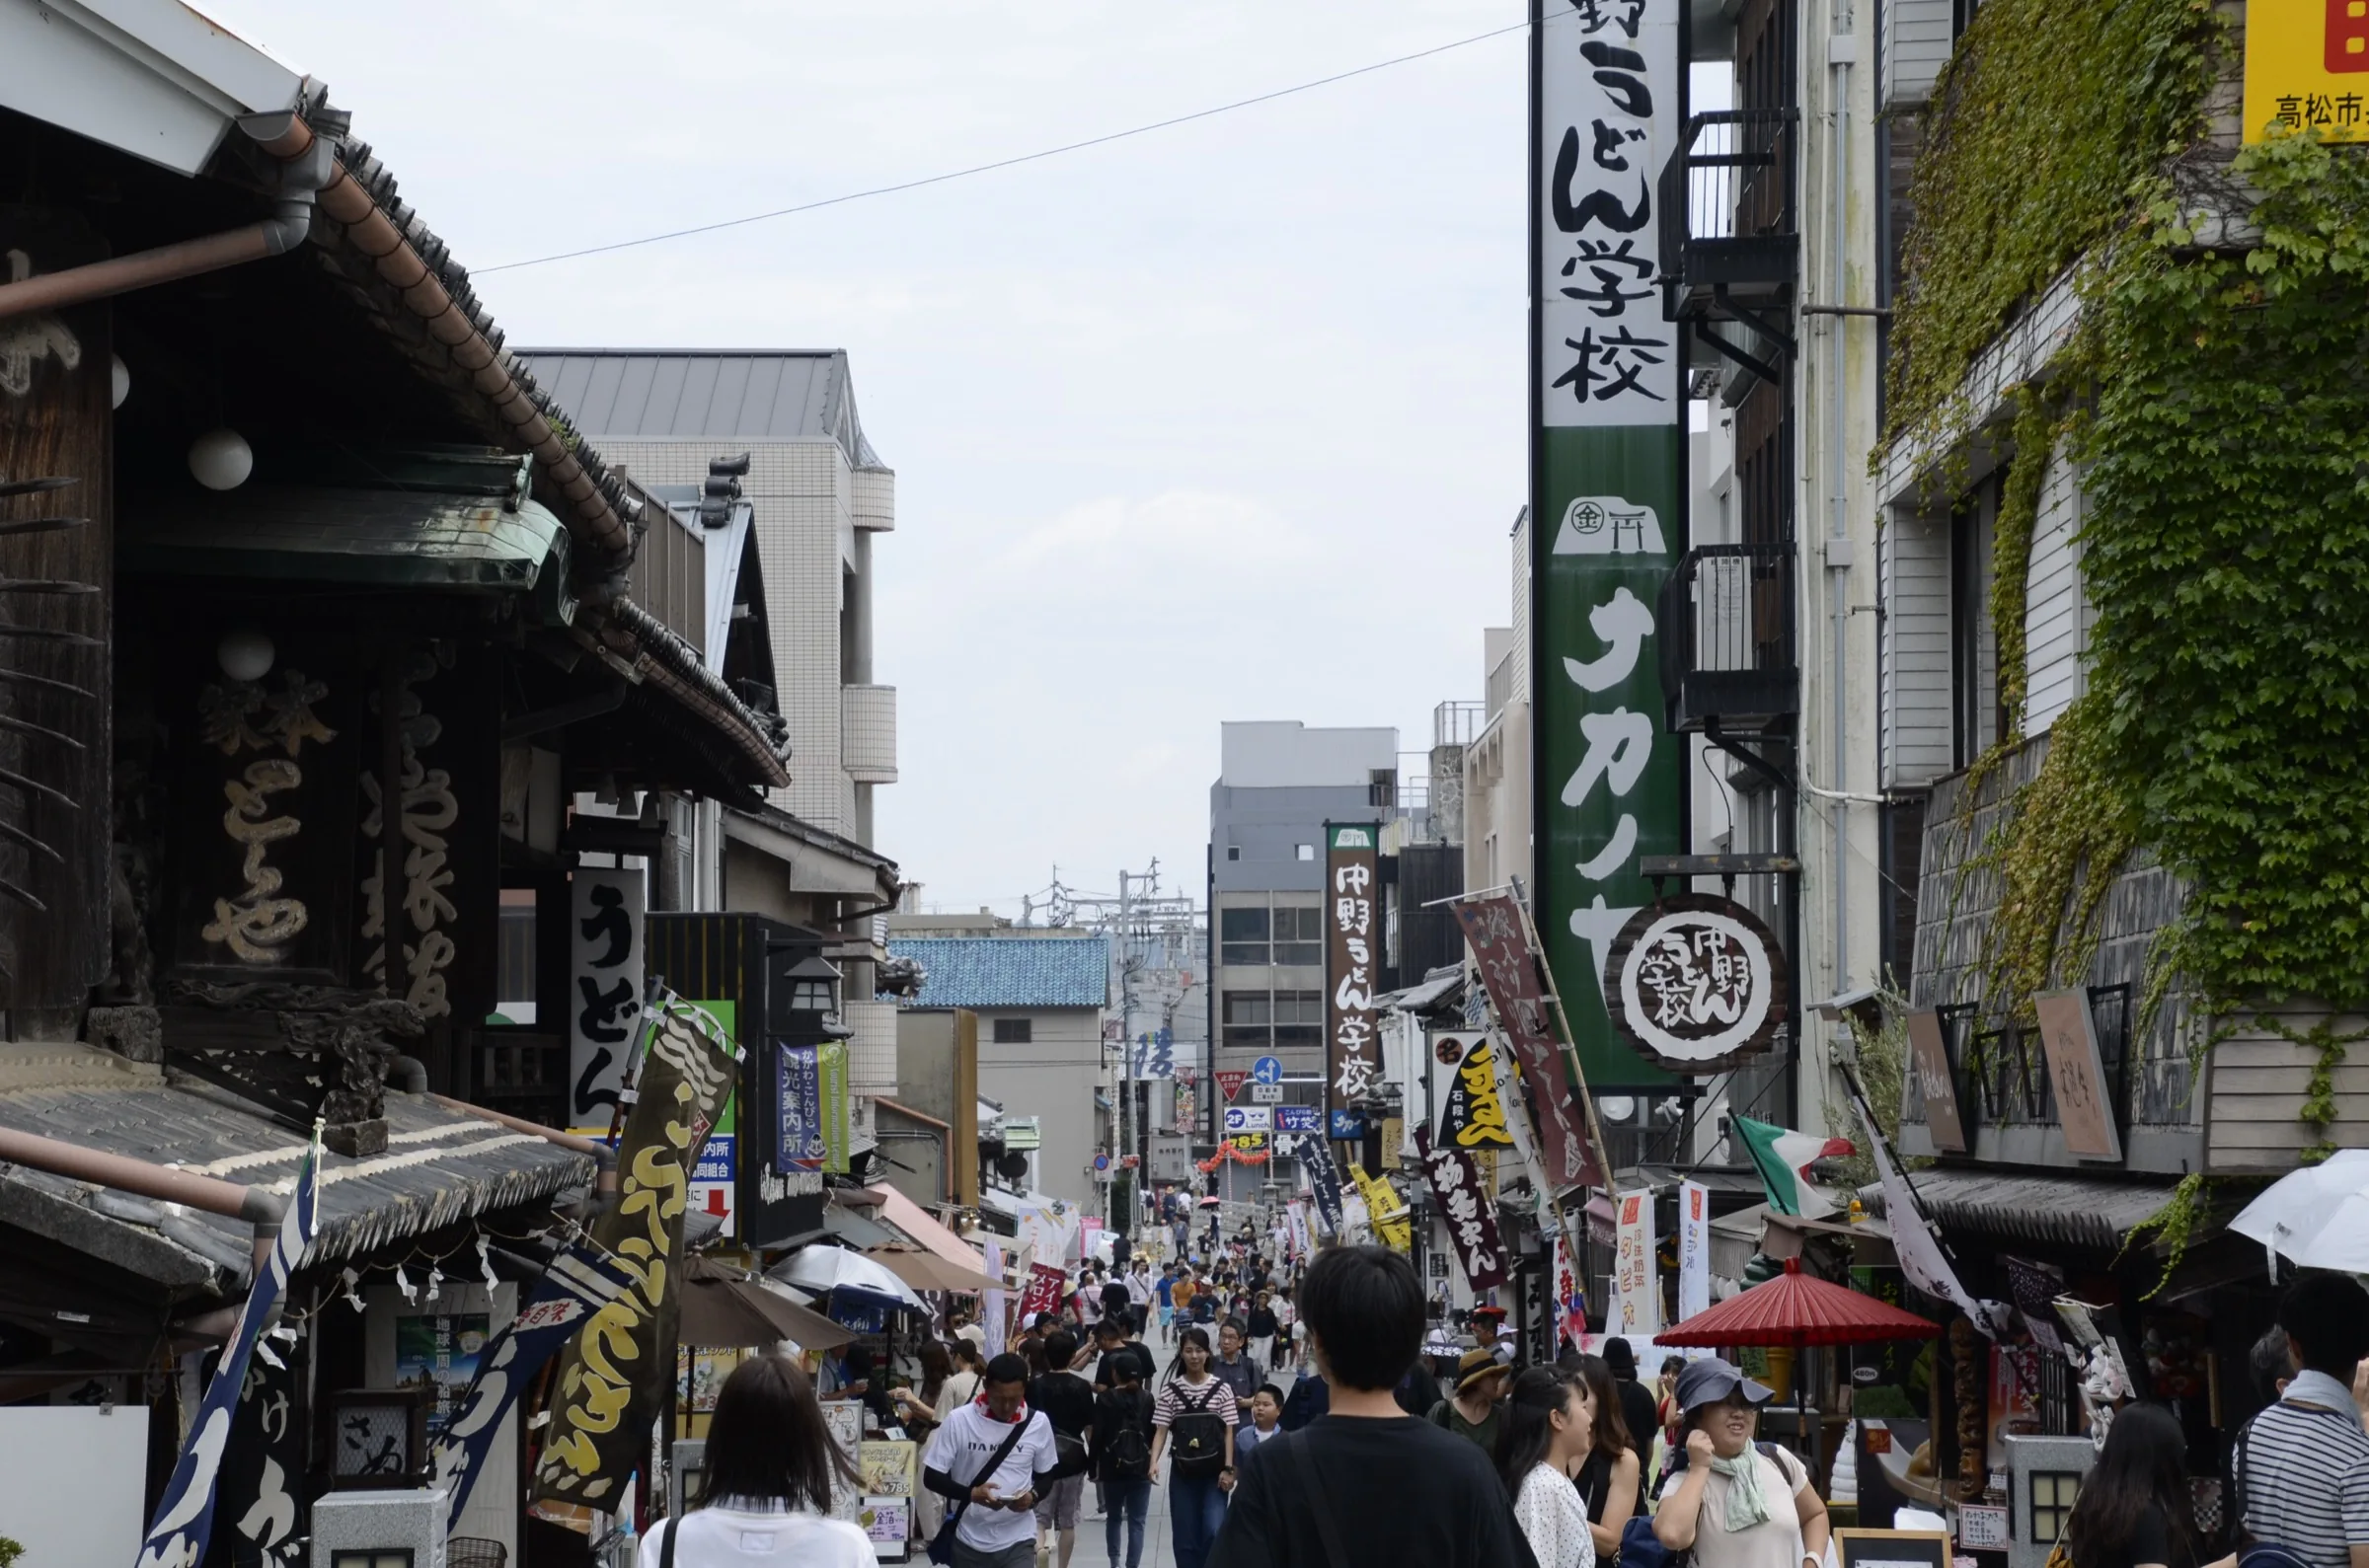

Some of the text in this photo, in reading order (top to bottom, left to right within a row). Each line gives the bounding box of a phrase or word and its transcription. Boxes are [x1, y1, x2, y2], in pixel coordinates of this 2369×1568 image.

[2275, 92, 2369, 129] 高松市
[574, 883, 640, 1117] うどん
[1335, 862, 1375, 1097] 中野うどん学校
[782, 1051, 802, 1154] 観光案内所
[1227, 1115, 1243, 1124] 2F
[1451, 1089, 1465, 1131] 石段や
[435, 1317, 451, 1414] 地球一周の船旅
[883, 1483, 910, 1493] ¥785
